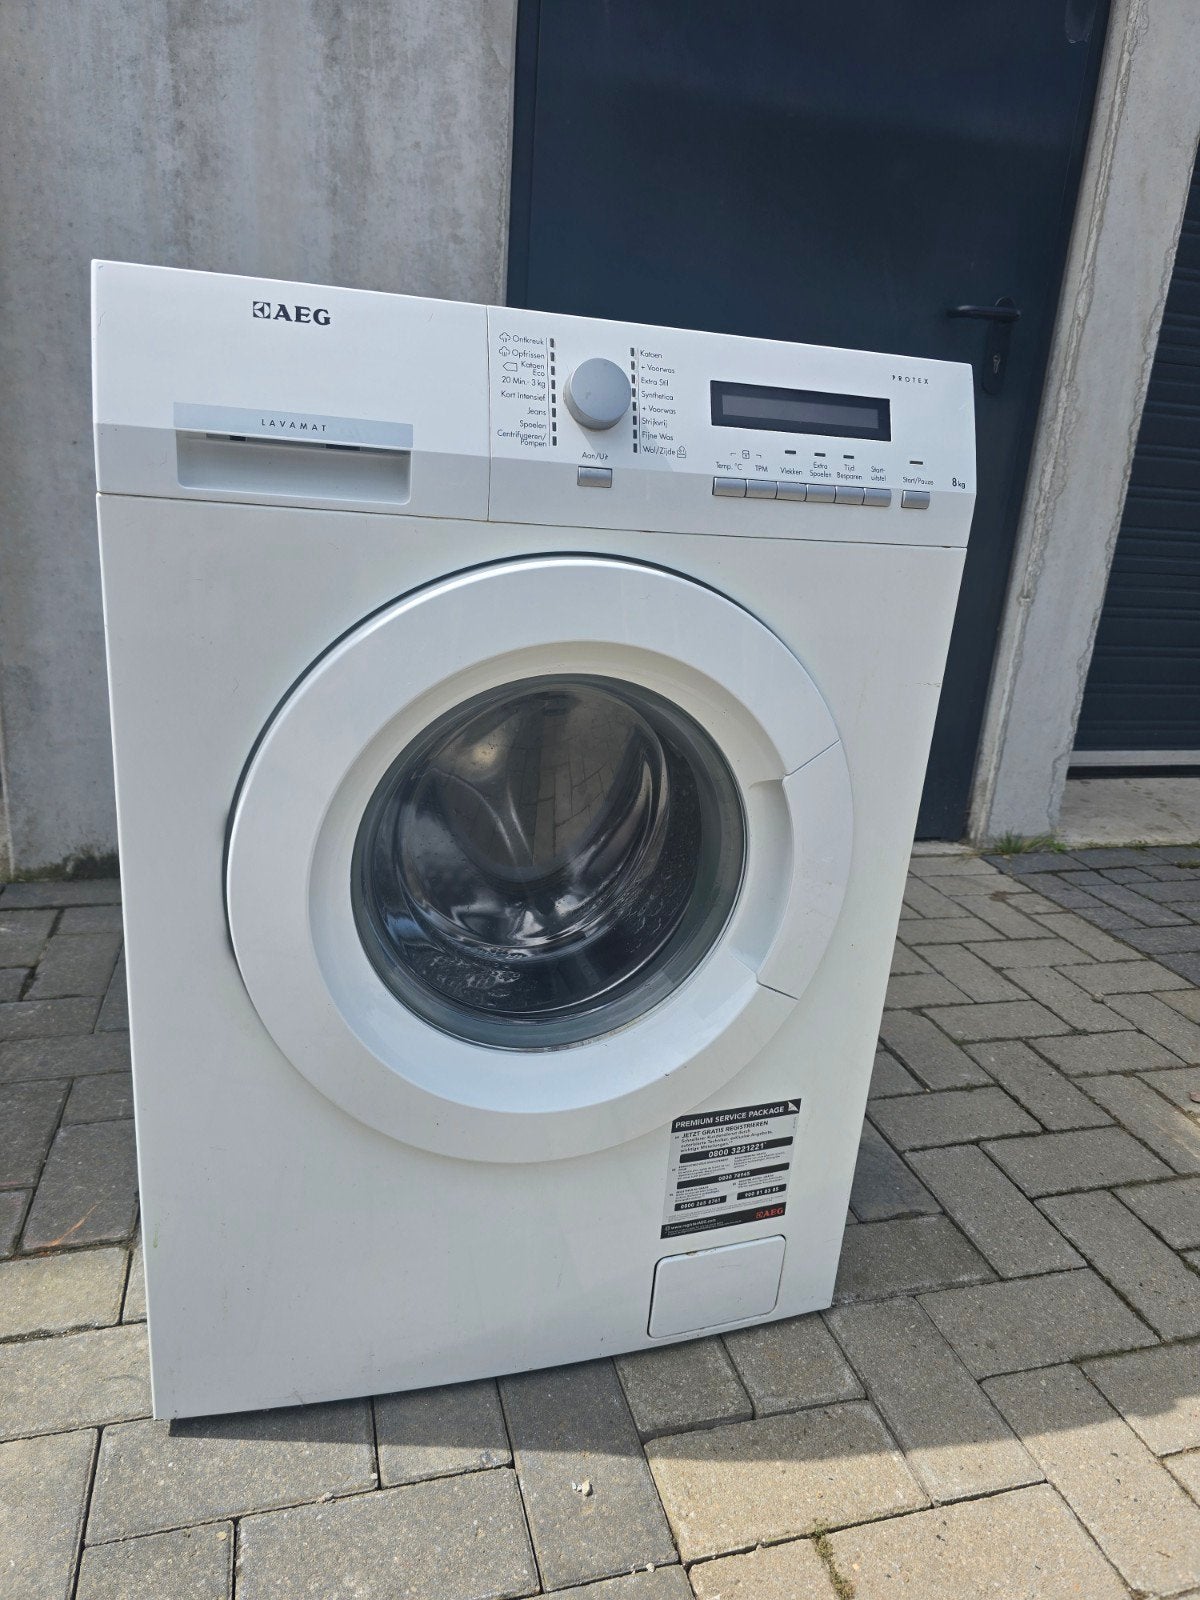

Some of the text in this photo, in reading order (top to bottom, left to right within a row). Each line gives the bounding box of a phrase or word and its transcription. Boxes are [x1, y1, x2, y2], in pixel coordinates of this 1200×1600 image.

[273, 303, 331, 326] AEG
[512, 334, 544, 345] Ontkreuk
[512, 349, 545, 359] Opfrissen
[640, 349, 663, 359] Katoen
[521, 361, 545, 370] Katoen
[647, 363, 675, 374] Voorwas
[532, 369, 545, 377] Eco
[501, 375, 511, 384] 20
[531, 379, 536, 387] 3
[537, 380, 546, 389] kg
[640, 377, 658, 386] Extra
[892, 374, 929, 385] PROTEX
[501, 390, 516, 399] Kort
[527, 407, 547, 416] Jeans
[648, 405, 677, 415] Voorwas
[261, 418, 327, 432] LAVAMAT
[519, 420, 547, 430] Spoelen
[641, 430, 674, 441] Fijne Was
[520, 438, 547, 448] Pompen
[642, 445, 676, 456] Wol/Zijde
[581, 451, 609, 461] Aan/Uit
[716, 461, 743, 471] Temp. °C
[813, 461, 828, 470] Extra
[844, 463, 855, 472] Tijd
[780, 467, 803, 476] Vlekken
[809, 470, 832, 479] Spoelen
[836, 471, 863, 481] Besparen
[675, 1106, 785, 1128] PREMIUM SERVICE PACKAGE
[681, 1131, 702, 1139] JETZT
[702, 1127, 724, 1136] GRATIS
[725, 1120, 769, 1132] REGISTRIEREN
[708, 1149, 729, 1158] 0800
